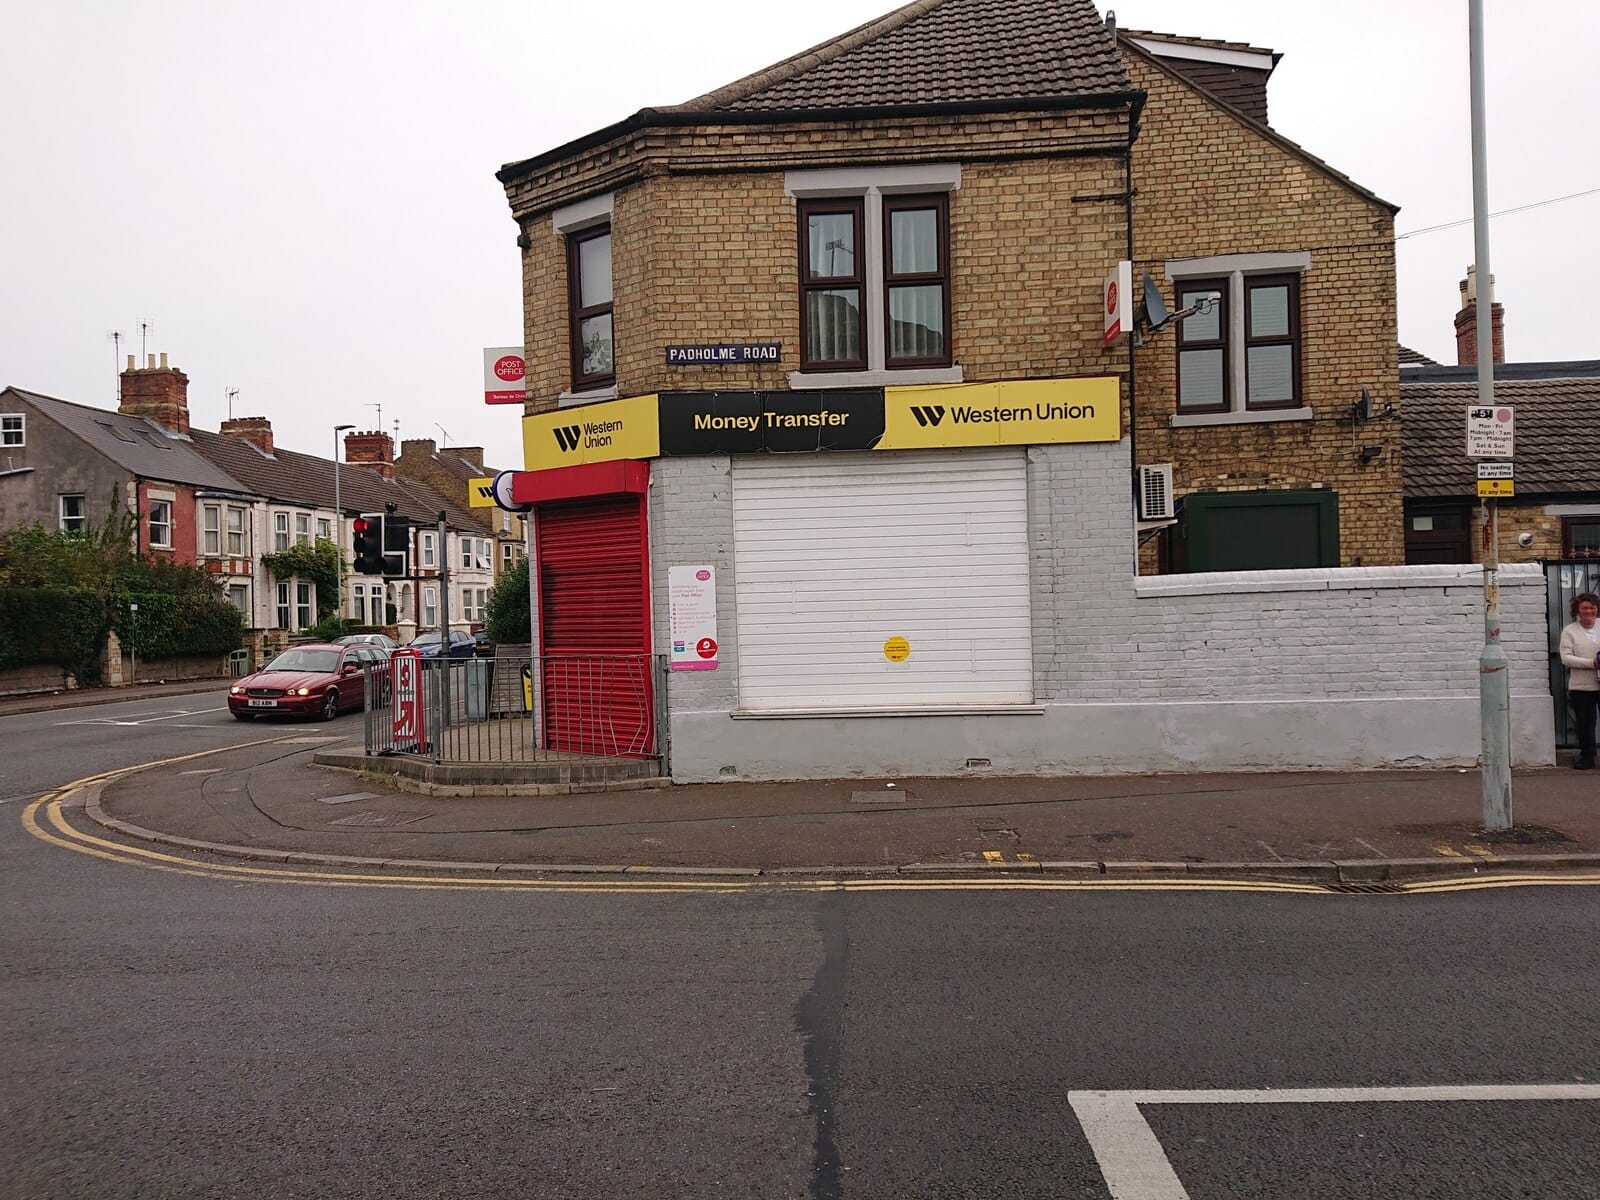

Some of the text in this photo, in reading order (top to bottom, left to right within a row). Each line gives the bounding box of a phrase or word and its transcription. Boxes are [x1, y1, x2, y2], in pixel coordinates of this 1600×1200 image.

[669, 346, 778, 361] PADHOLME ROAD
[497, 368, 524, 376] OFFICE
[501, 360, 521, 368] POST
[693, 410, 850, 431] Money Transfer
[950, 405, 1033, 425] Western
[1036, 401, 1095, 421] Union
[583, 418, 623, 436] Western
[583, 433, 613, 449] Union
[1560, 567, 1584, 589] 97
